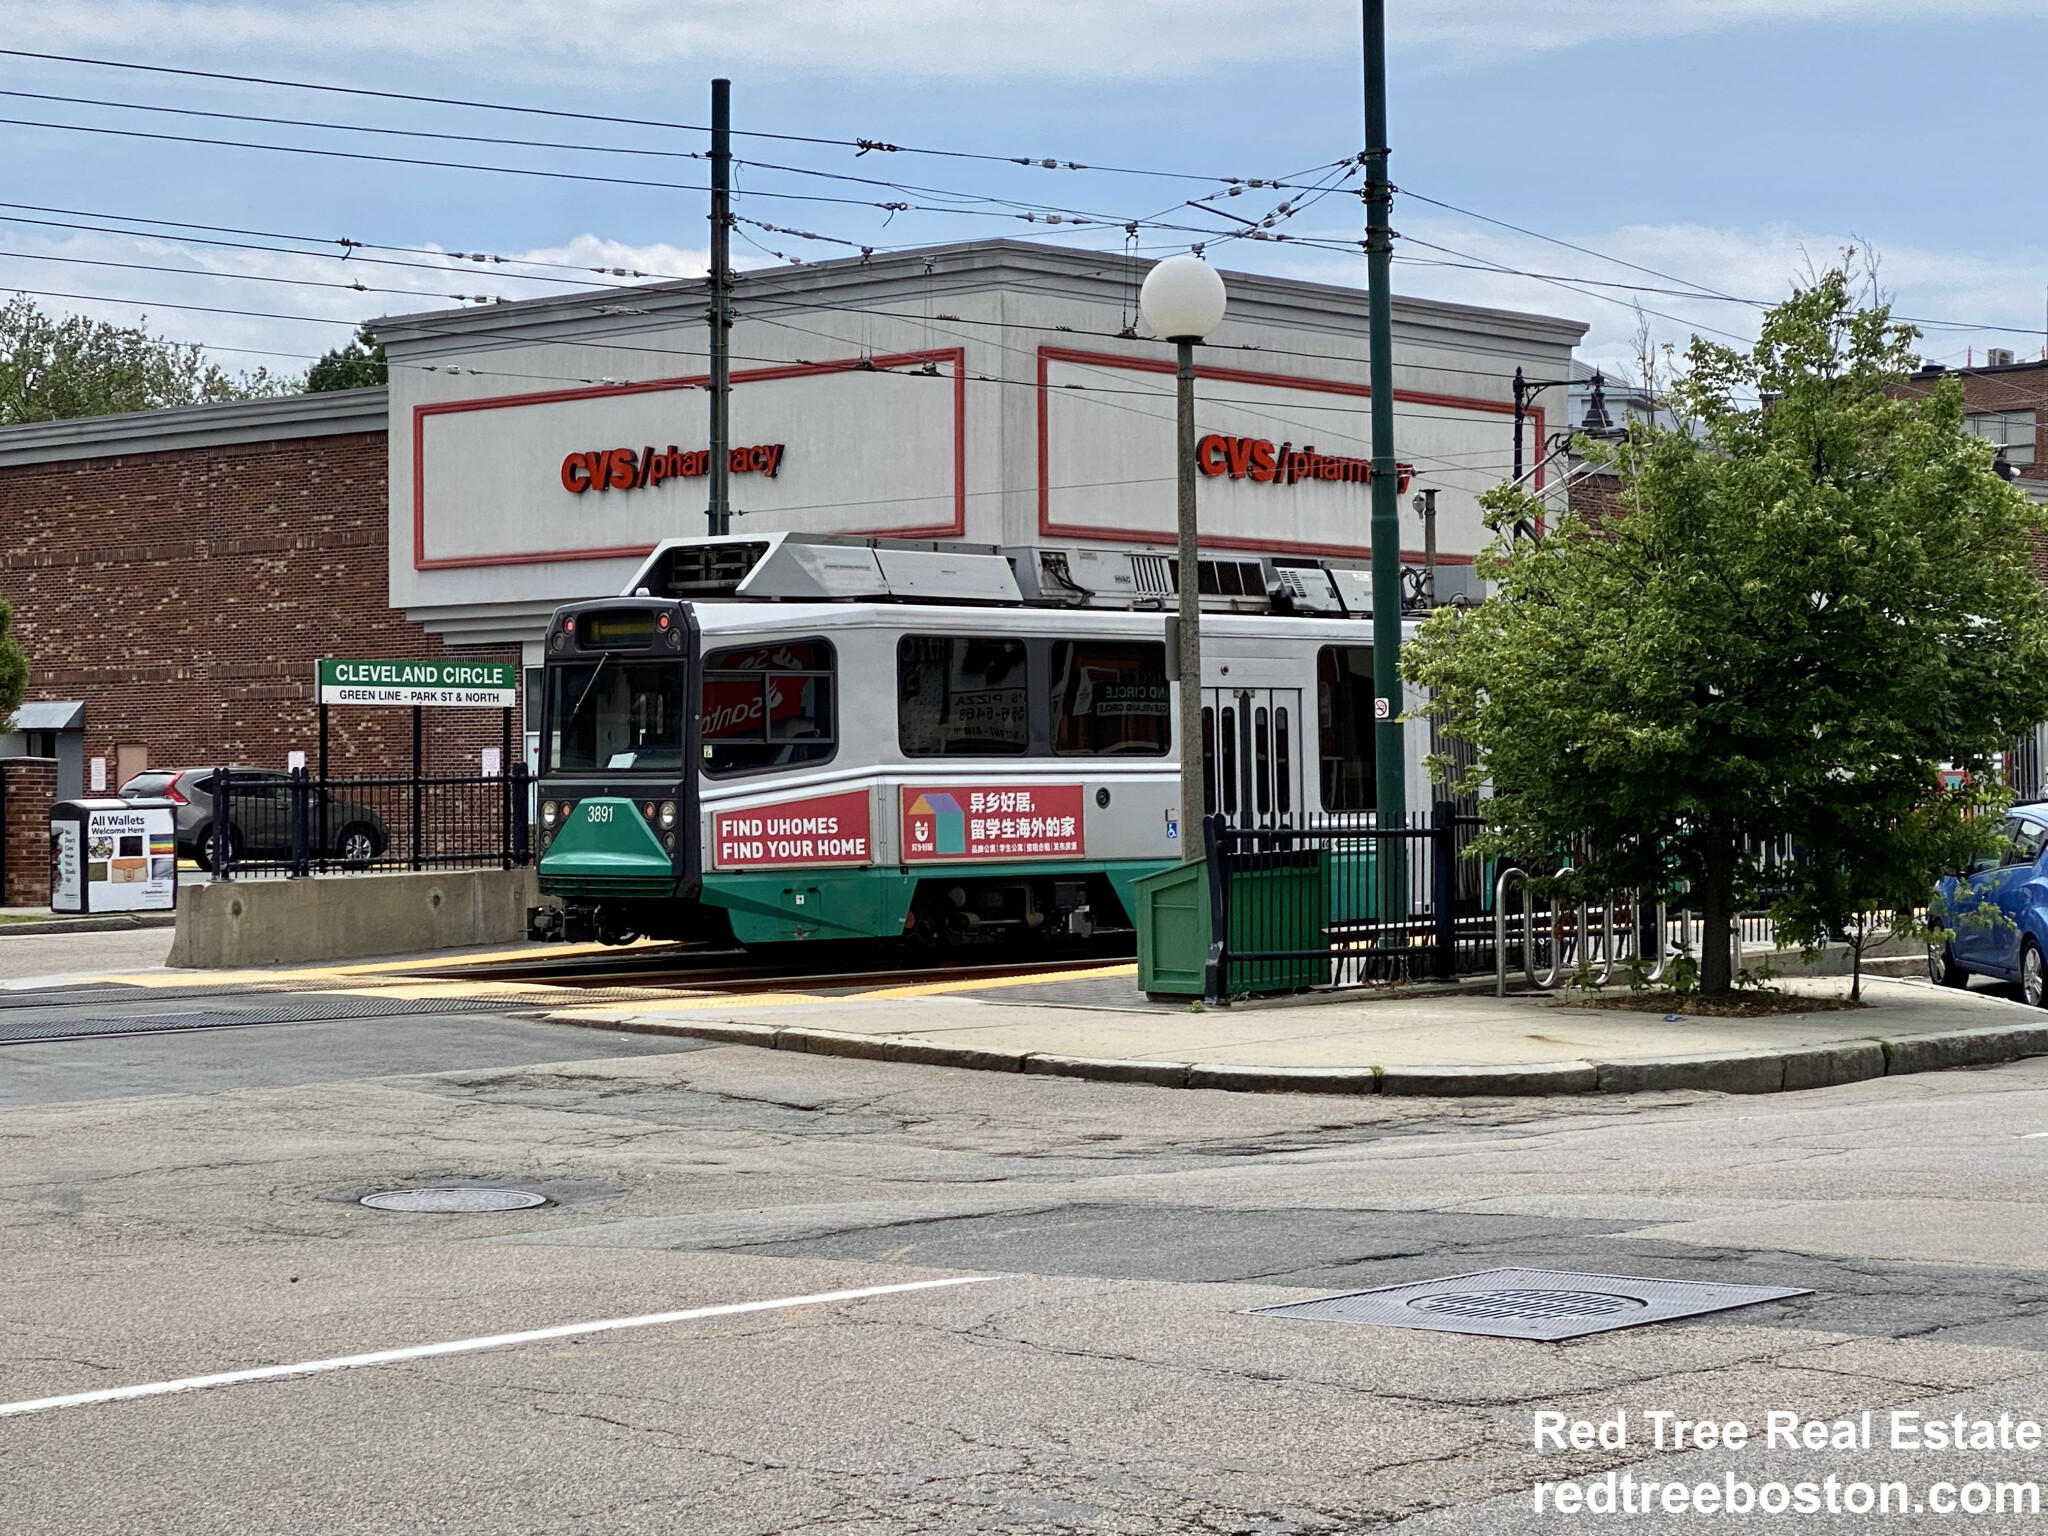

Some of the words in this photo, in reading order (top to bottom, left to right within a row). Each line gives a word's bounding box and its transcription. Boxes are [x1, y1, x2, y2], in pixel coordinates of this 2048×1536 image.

[561, 444, 785, 493] CVS/pharacy
[335, 664, 438, 683] CLEVELAND
[442, 667, 503, 684] CIRCLE
[339, 690, 376, 700] GREEN
[379, 691, 401, 701] LINE
[410, 692, 438, 702] PARK
[441, 693, 453, 702] ST
[456, 693, 463, 702] &
[467, 694, 500, 703] NORTH
[91, 816, 106, 826] All
[107, 815, 145, 826] Wallets
[587, 805, 614, 823] 3891
[721, 819, 763, 837] FIND
[767, 817, 838, 836] UHOMES
[971, 817, 1075, 840] 留学生海外的家
[722, 841, 763, 859] FIND
[767, 840, 814, 858] YOUR
[817, 838, 866, 856] HOME
